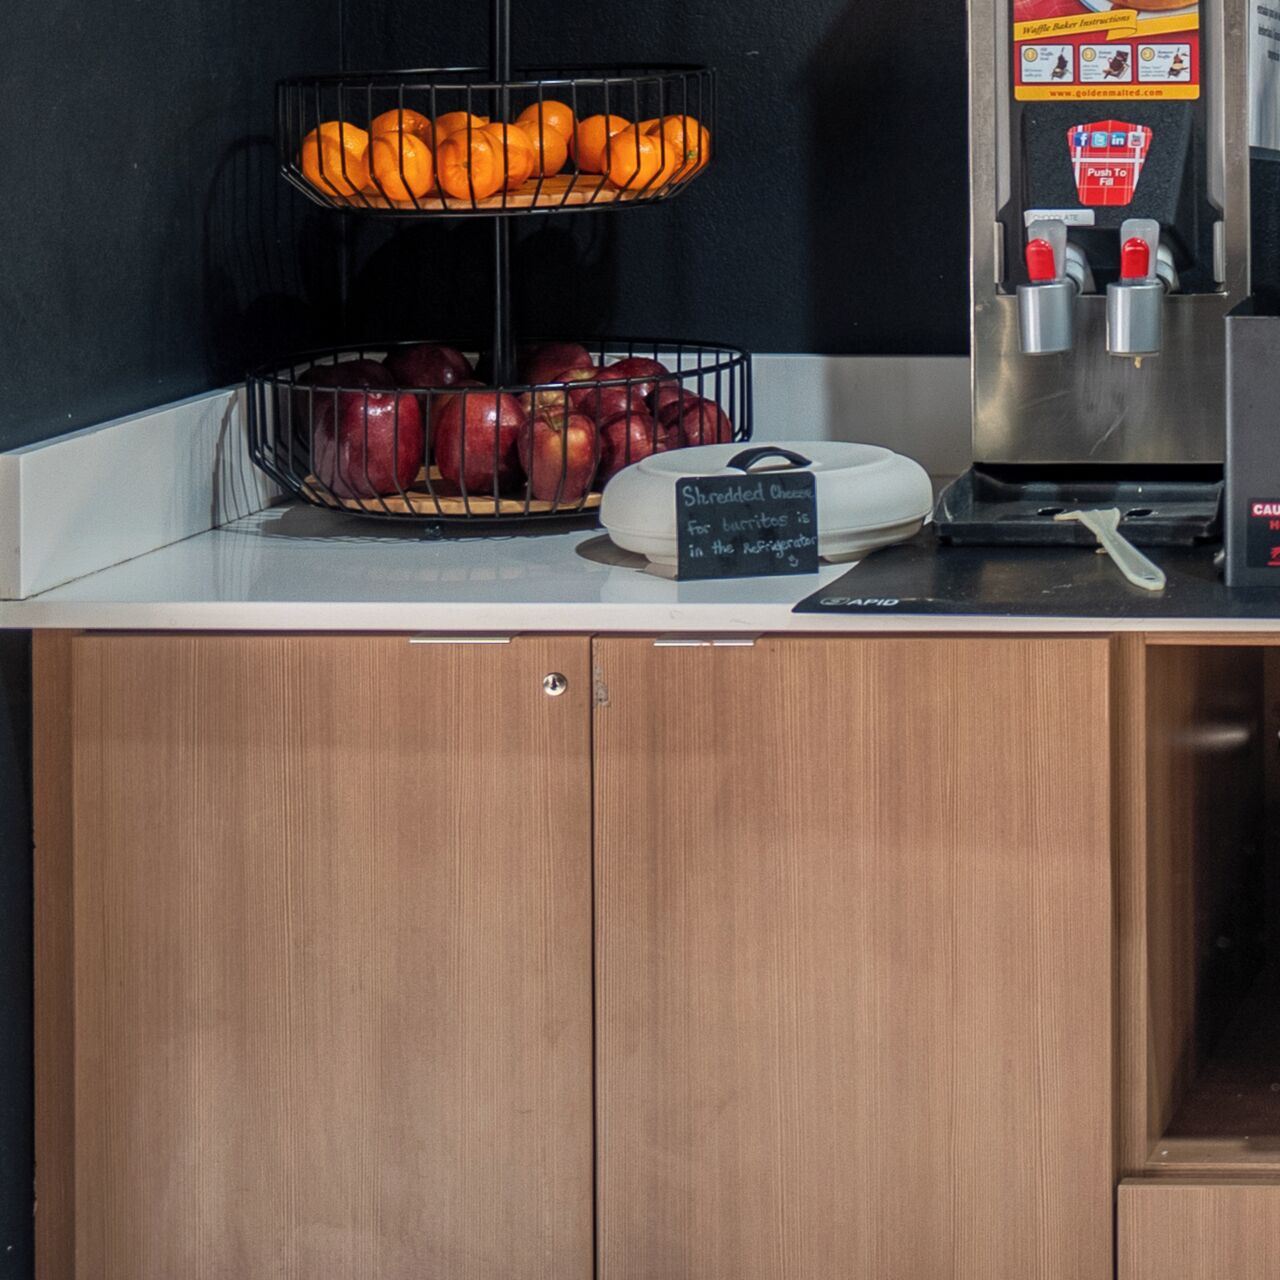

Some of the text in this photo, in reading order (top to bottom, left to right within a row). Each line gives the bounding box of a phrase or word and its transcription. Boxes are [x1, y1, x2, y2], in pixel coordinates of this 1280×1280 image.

[1022, 14, 1131, 35] Waffle Baker Instructions
[1050, 88, 1163, 98] www.goldenmalted.com
[1111, 133, 1125, 146] in
[1088, 168, 1127, 177] Push To
[1100, 178, 1114, 186] Fill
[682, 482, 766, 507] Shredded
[796, 511, 811, 524] is
[689, 544, 704, 558] in
[711, 540, 736, 555] the
